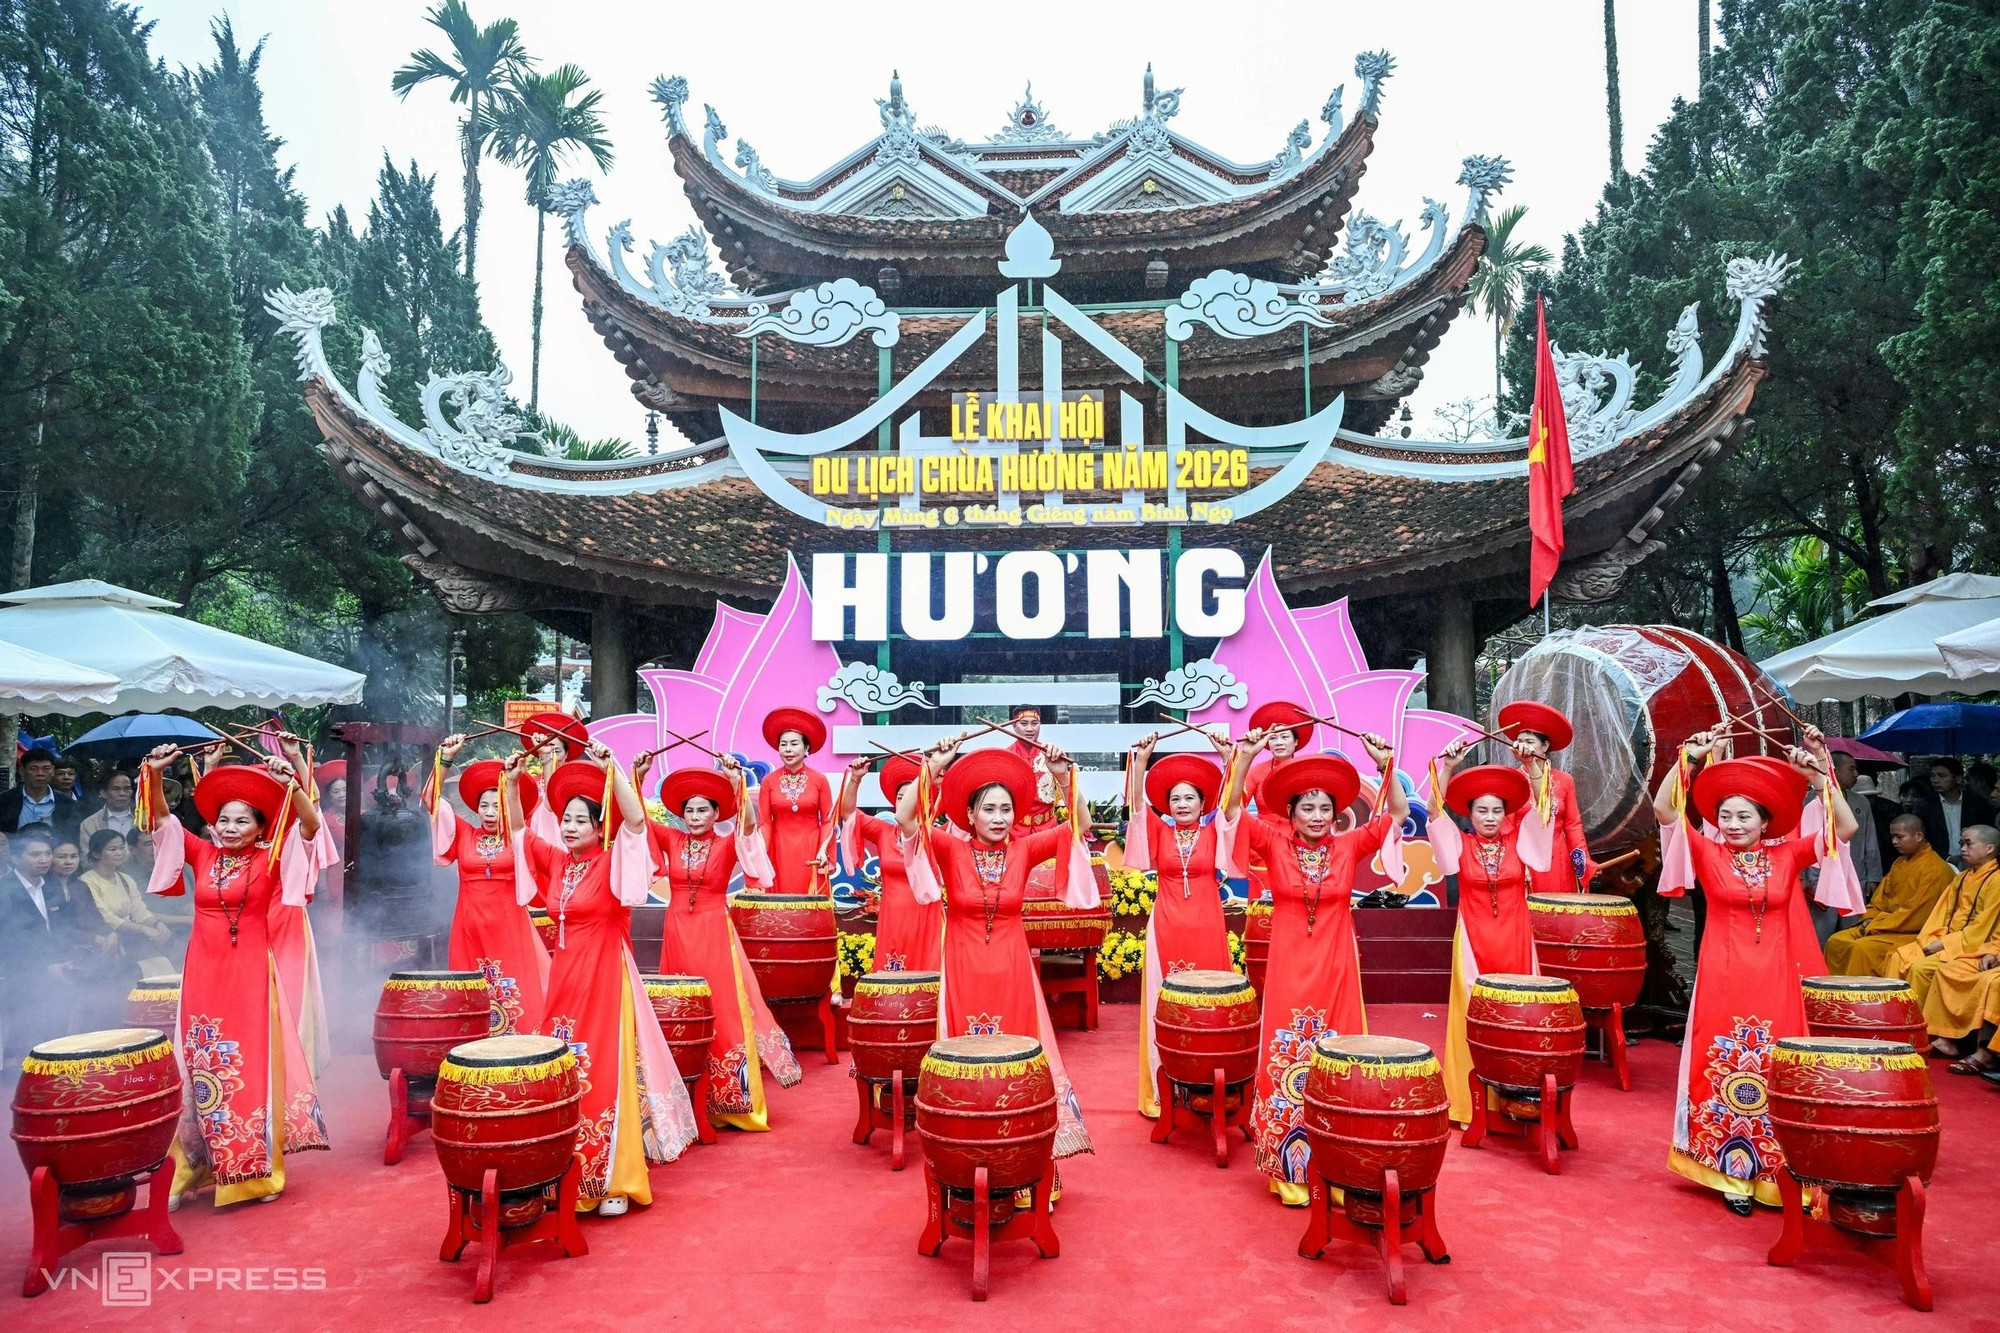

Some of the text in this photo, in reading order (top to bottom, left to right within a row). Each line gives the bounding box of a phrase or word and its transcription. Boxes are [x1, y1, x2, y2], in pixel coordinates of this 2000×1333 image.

[951, 390, 1104, 446] LỄ KHAI HỘI
[812, 443, 1249, 500] DU LỊCH CHÙA HƯƠNG NĂM 2026
[825, 508, 877, 528] Ngày
[883, 508, 939, 527] Mùng
[944, 506, 959, 525] 6
[964, 504, 1023, 526] tháng
[1027, 504, 1088, 525] Giêng
[1141, 502, 1189, 522] Bính
[1191, 502, 1233, 525] Ngọ
[811, 548, 1246, 642] HƯƠNG
[123, 1074, 144, 1086] Hoa
